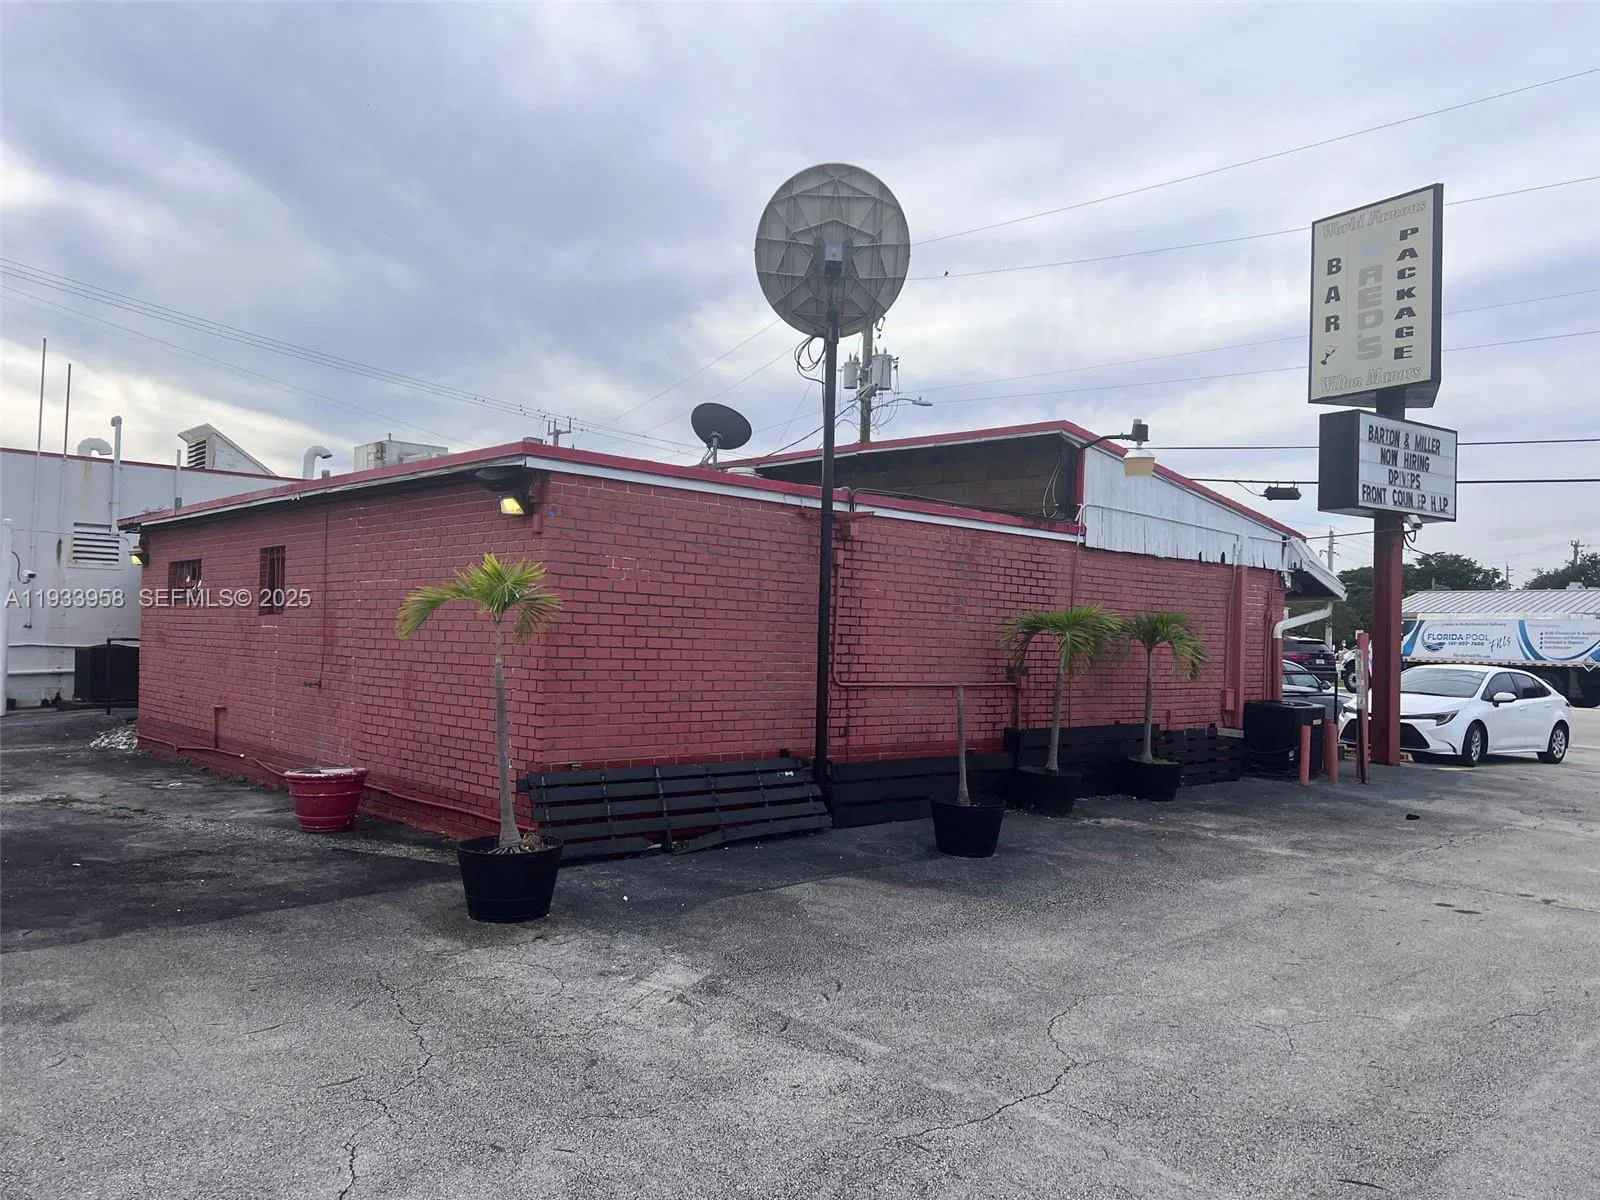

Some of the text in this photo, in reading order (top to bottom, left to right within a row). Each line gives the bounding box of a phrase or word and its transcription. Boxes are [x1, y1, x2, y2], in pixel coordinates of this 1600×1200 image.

[1323, 202, 1426, 239] World Famous
[1324, 257, 1342, 333] BAR
[1394, 227, 1419, 360] PACKAGE
[1320, 366, 1422, 393] Wilton Manors
[1368, 425, 1441, 456] BARTON & MILLER
[1380, 447, 1430, 472] NOW HIRING
[1362, 484, 1387, 504] FRONT
[1431, 496, 1448, 513] HLP
[1427, 633, 1464, 641] FLORIDA
[1466, 633, 1489, 641] POOL
